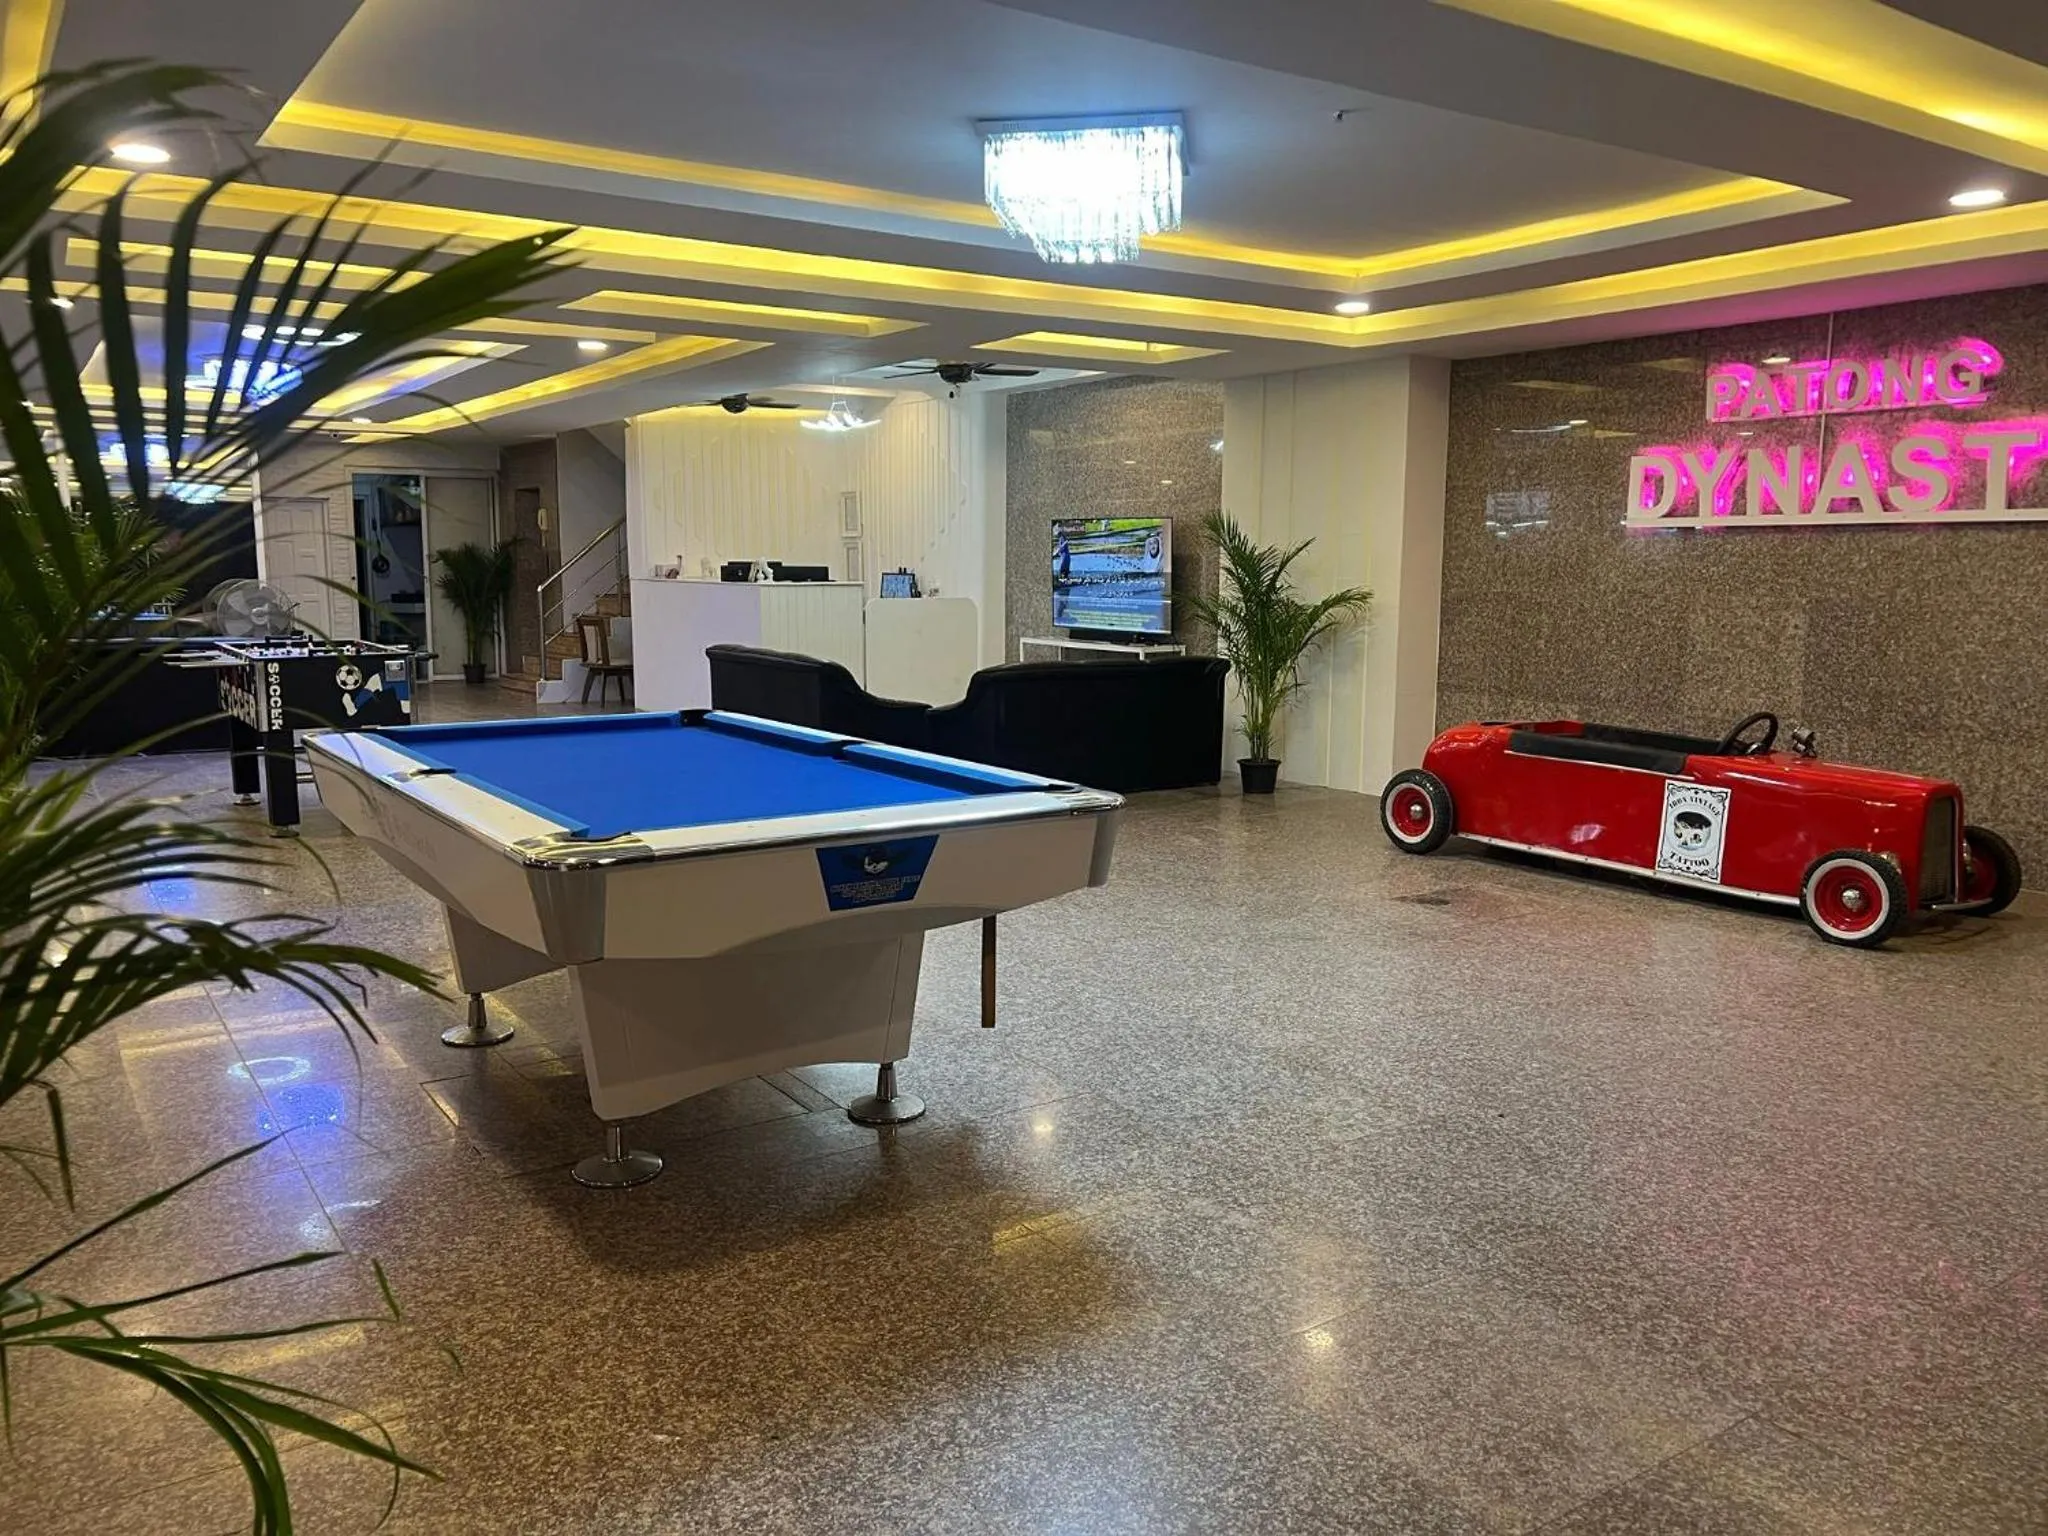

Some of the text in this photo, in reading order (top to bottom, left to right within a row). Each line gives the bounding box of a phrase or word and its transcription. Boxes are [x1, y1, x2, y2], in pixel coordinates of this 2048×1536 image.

[1706, 347, 1986, 422] PATONG
[267, 662, 284, 730] SOCCER
[1669, 850, 1710, 867] TATTOO
